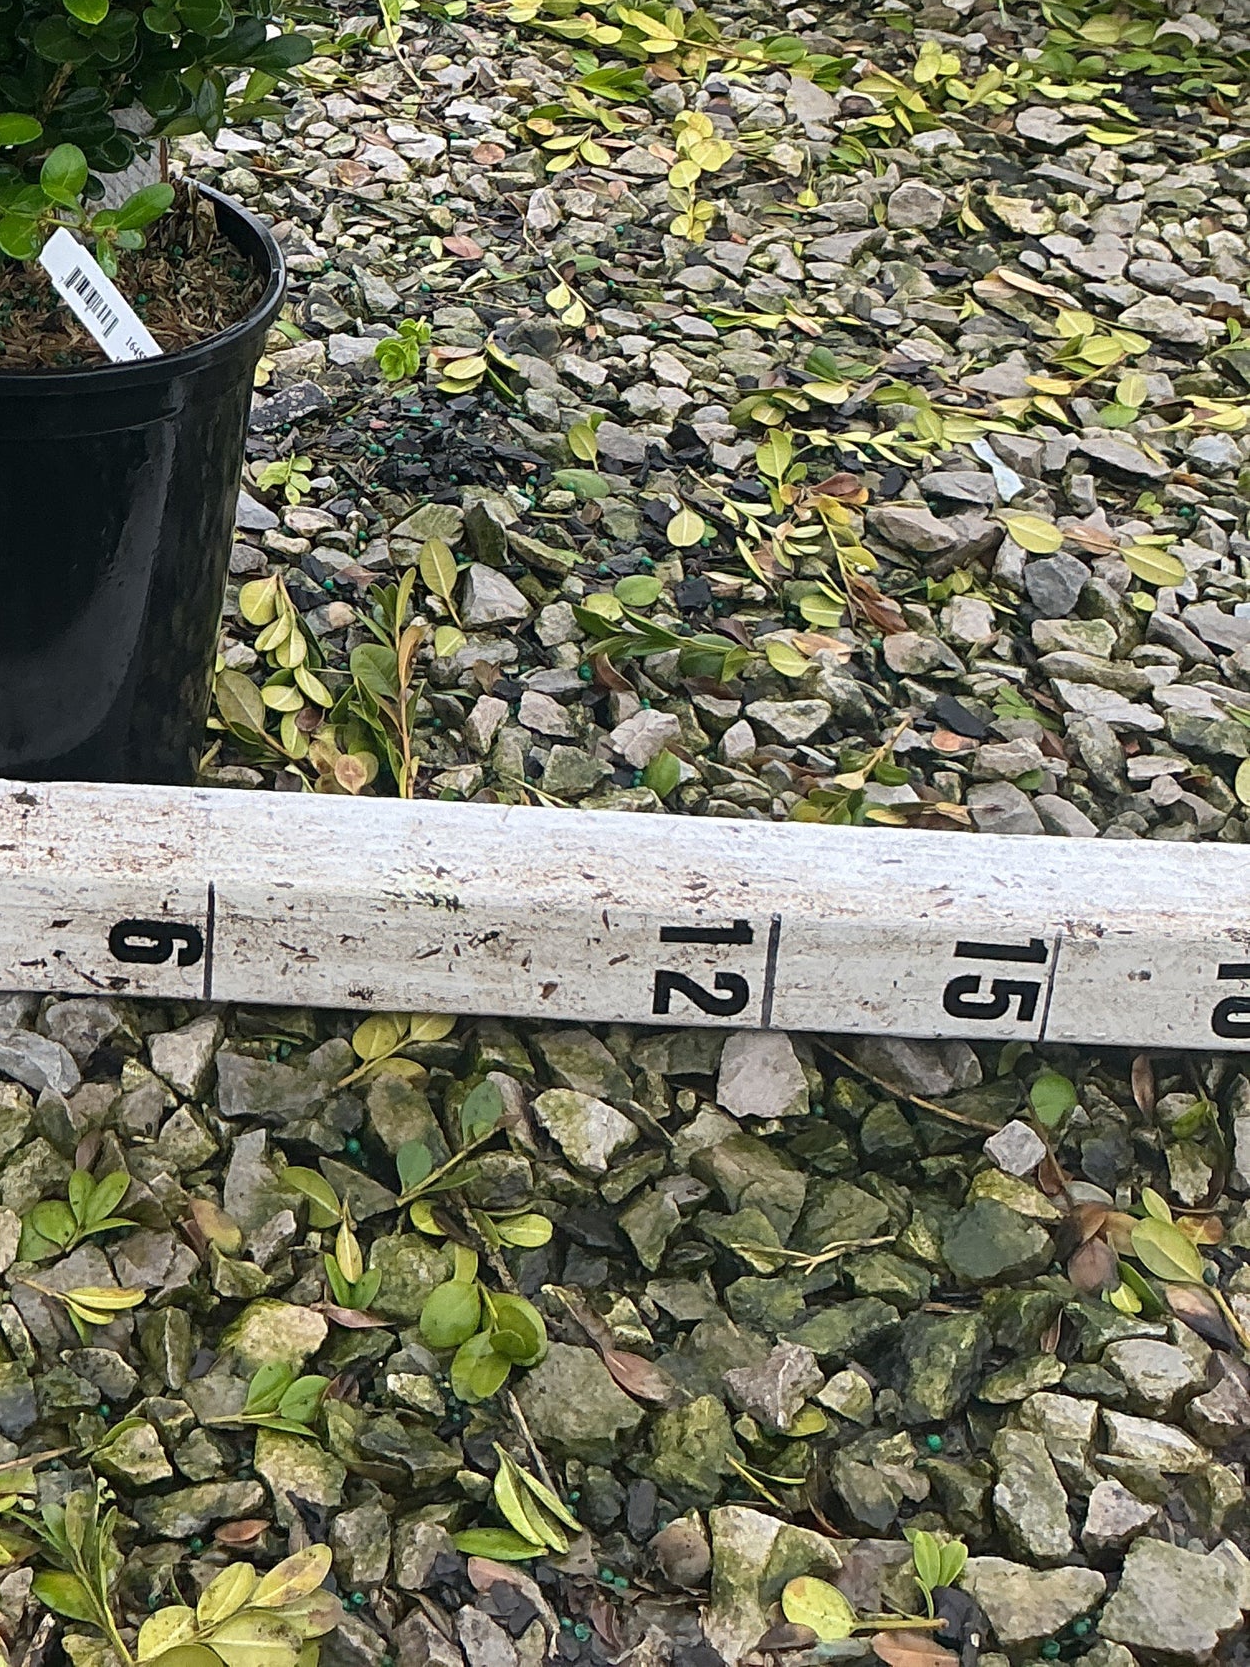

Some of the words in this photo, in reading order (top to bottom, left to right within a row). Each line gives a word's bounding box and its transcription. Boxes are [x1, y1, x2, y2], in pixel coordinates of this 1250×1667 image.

[125, 336, 147, 360] 1645
[108, 918, 204, 967] 6
[653, 919, 755, 1018] 12
[943, 938, 1049, 1022] 15
